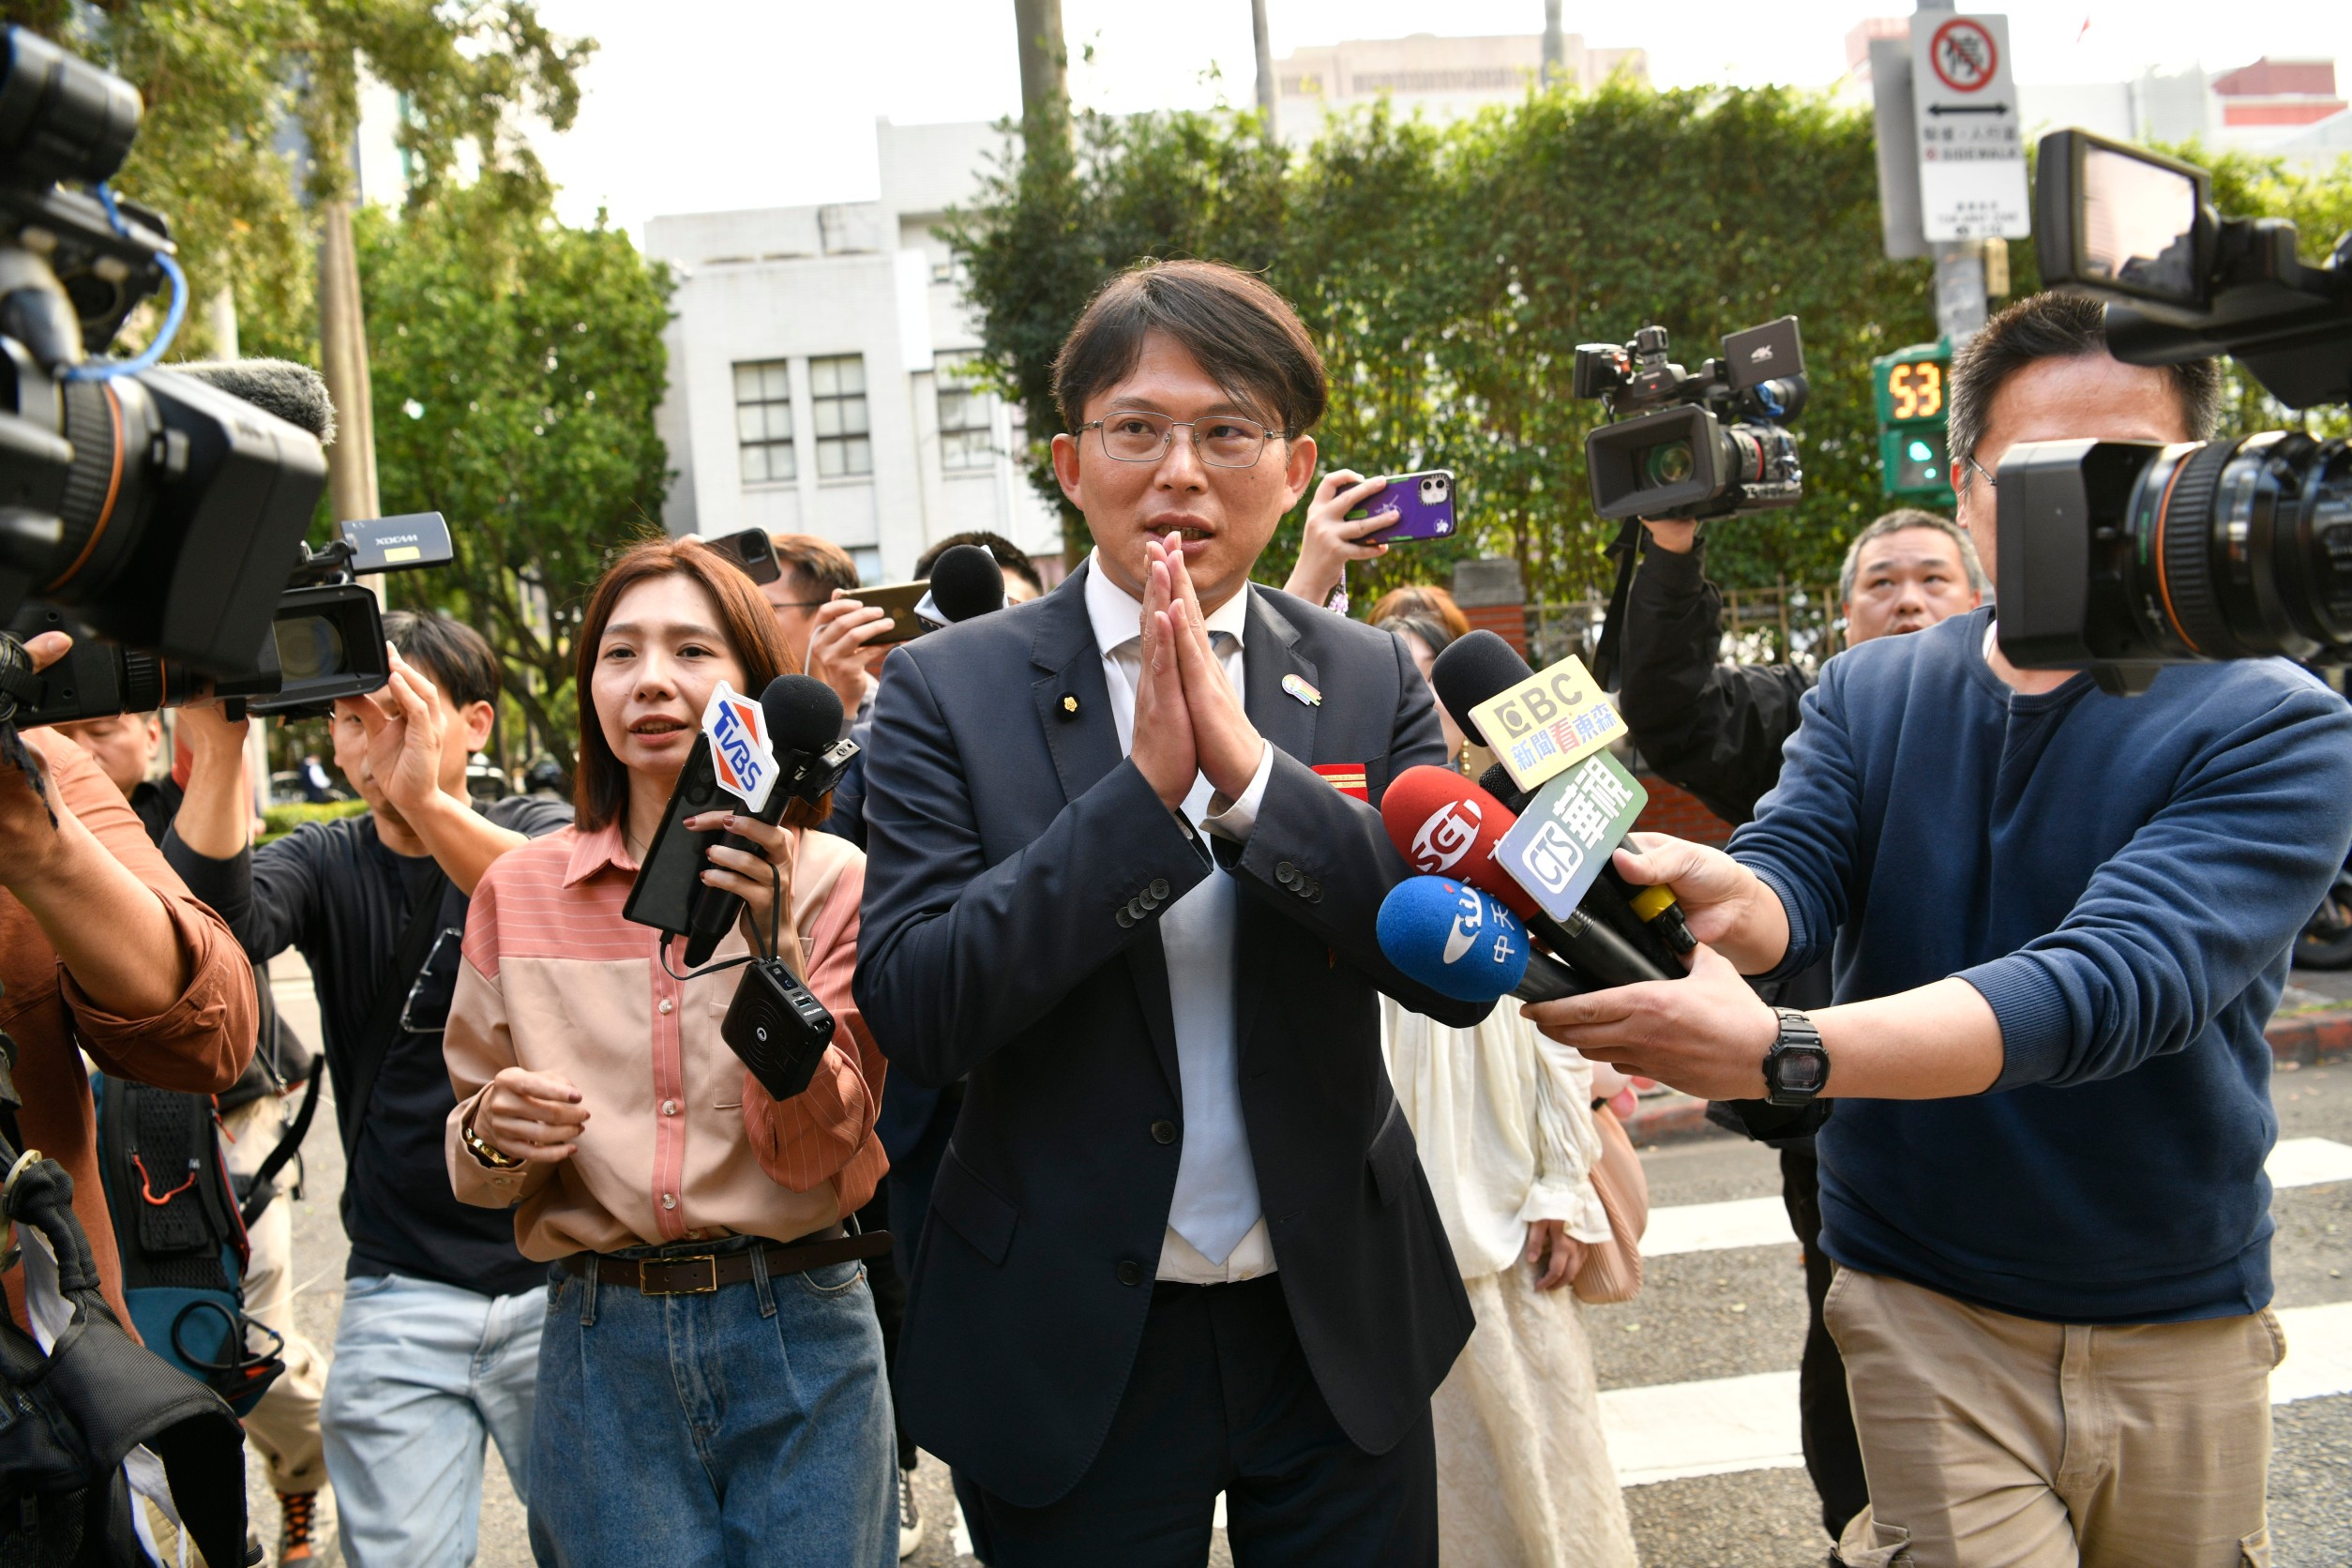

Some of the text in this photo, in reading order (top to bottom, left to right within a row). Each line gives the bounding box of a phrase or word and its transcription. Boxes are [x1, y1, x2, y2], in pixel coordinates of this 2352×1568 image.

[1890, 362, 1941, 418] 53
[714, 700, 762, 792] TVBS
[1510, 702, 1617, 772] 新聞看東森
[1529, 754, 1635, 886] CTS 華視
